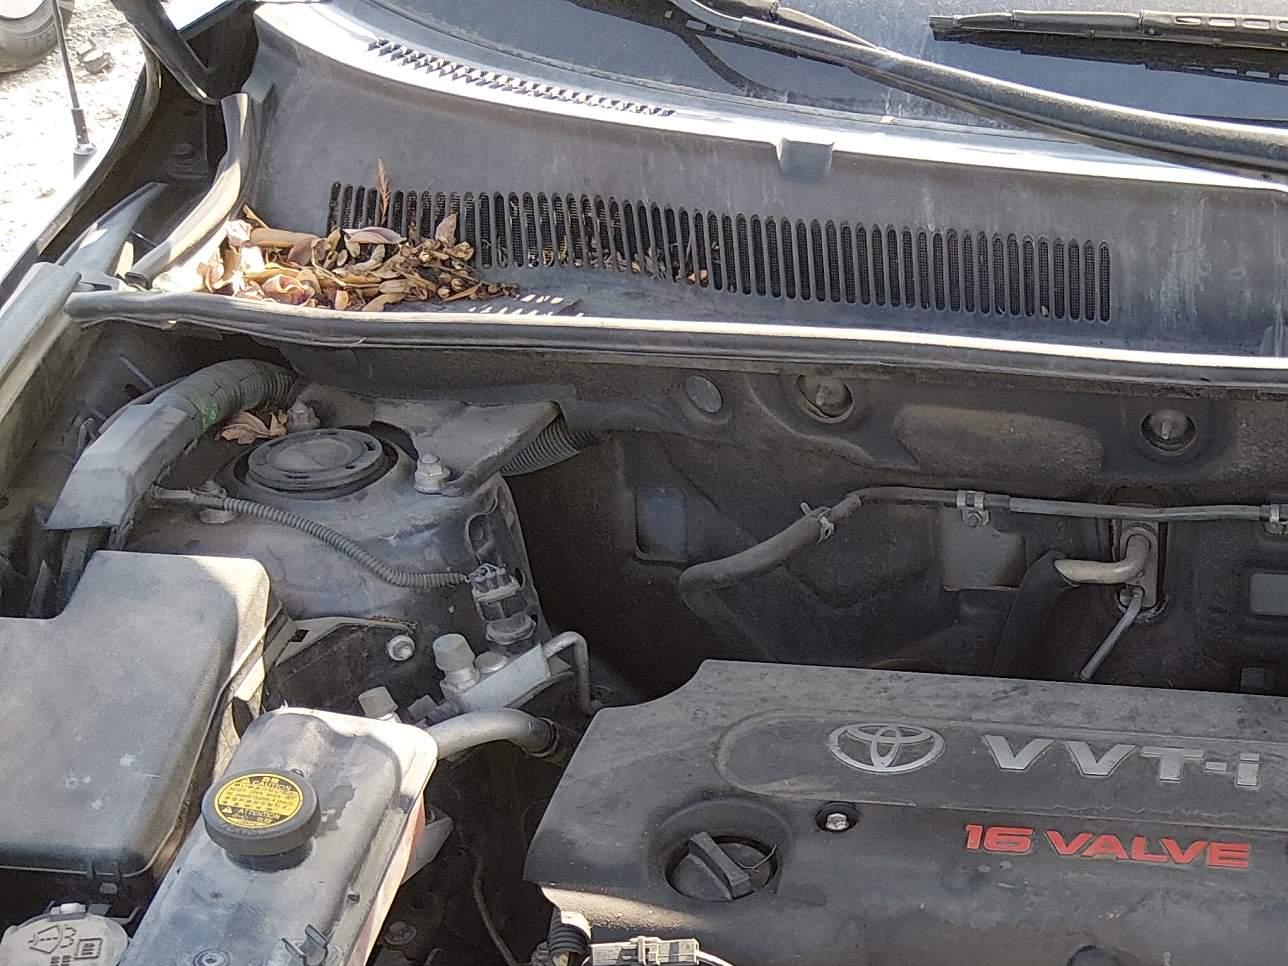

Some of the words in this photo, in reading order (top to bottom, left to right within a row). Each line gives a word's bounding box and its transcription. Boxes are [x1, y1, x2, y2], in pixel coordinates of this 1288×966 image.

[982, 734, 1261, 787] VVT-i
[252, 780, 291, 791] CAUTION
[238, 808, 280, 820] ATTENTION
[965, 824, 1034, 853] 16
[1045, 830, 1249, 868] VALVE
